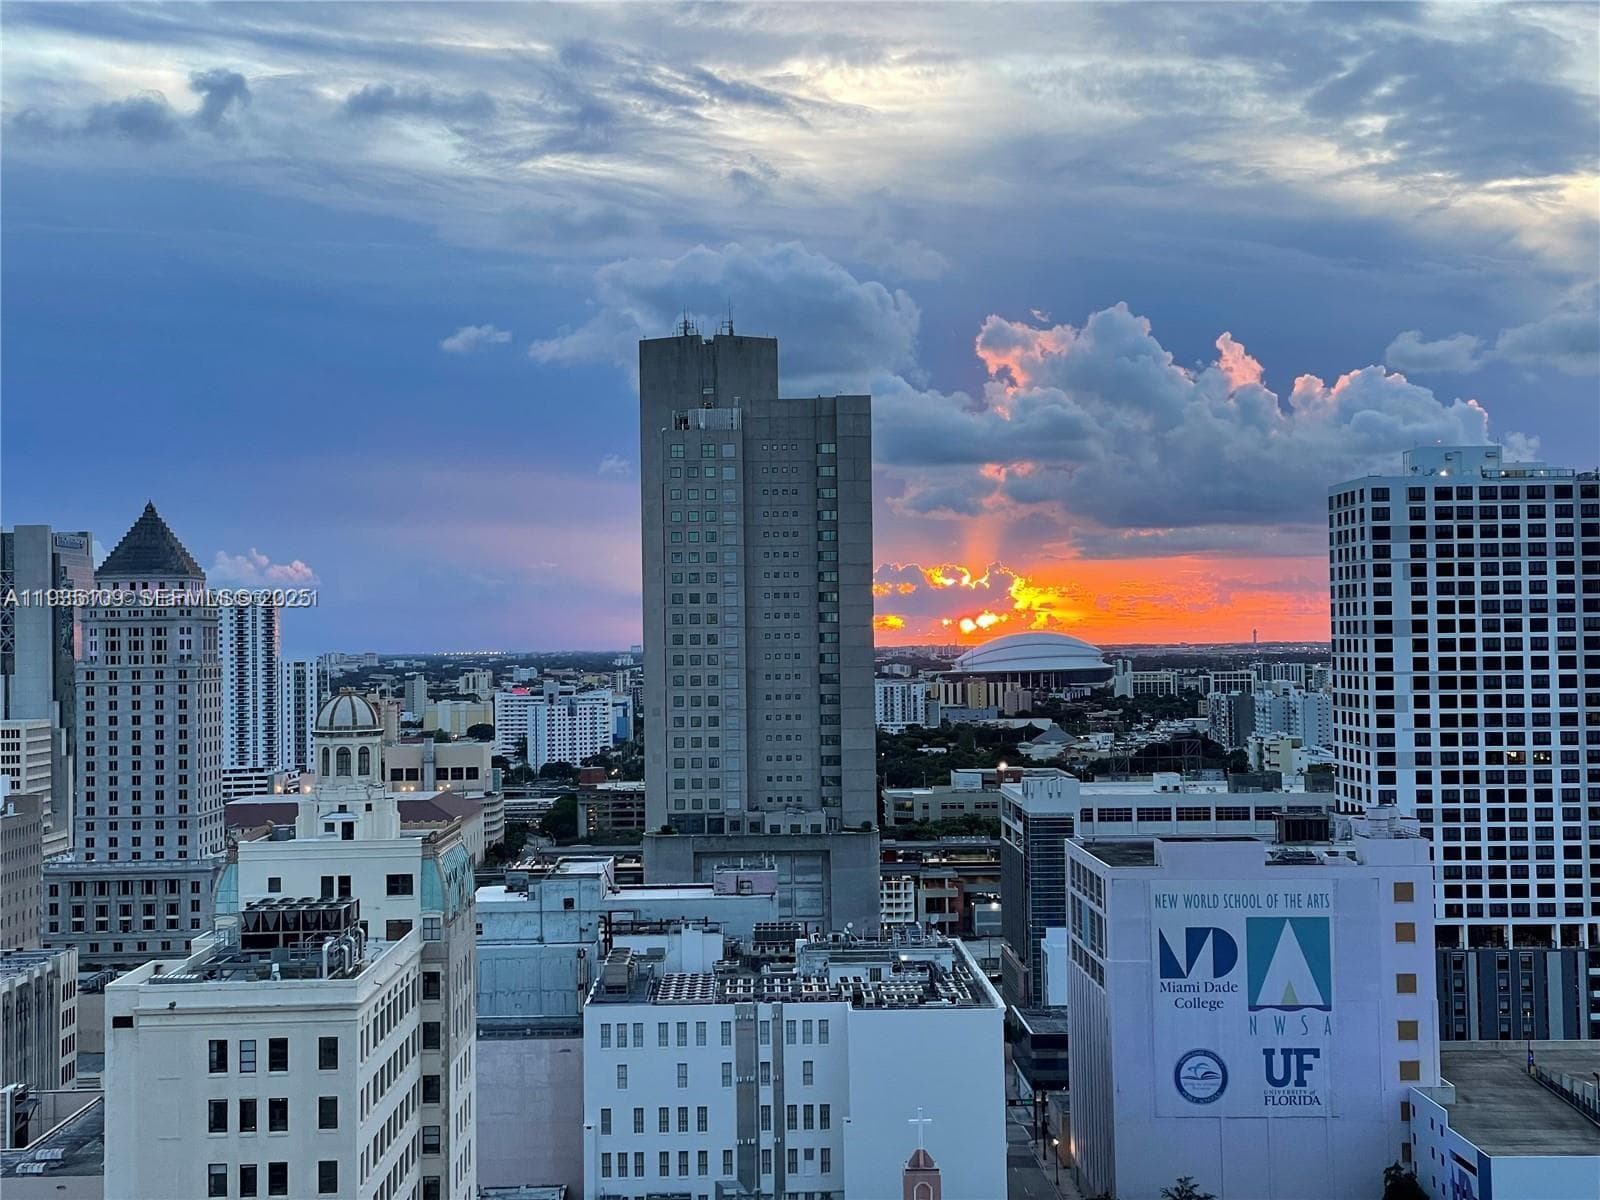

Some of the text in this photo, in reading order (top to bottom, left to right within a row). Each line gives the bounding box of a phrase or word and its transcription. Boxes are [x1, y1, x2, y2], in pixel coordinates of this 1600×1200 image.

[1154, 893, 1330, 909] NEW WORLD SCHOOL OF THE ARTS
[1159, 981, 1239, 993] Miami Dade
[1174, 997, 1225, 1012] College
[1262, 1048, 1320, 1087] UF
[1264, 1095, 1322, 1106] FLORIDA
